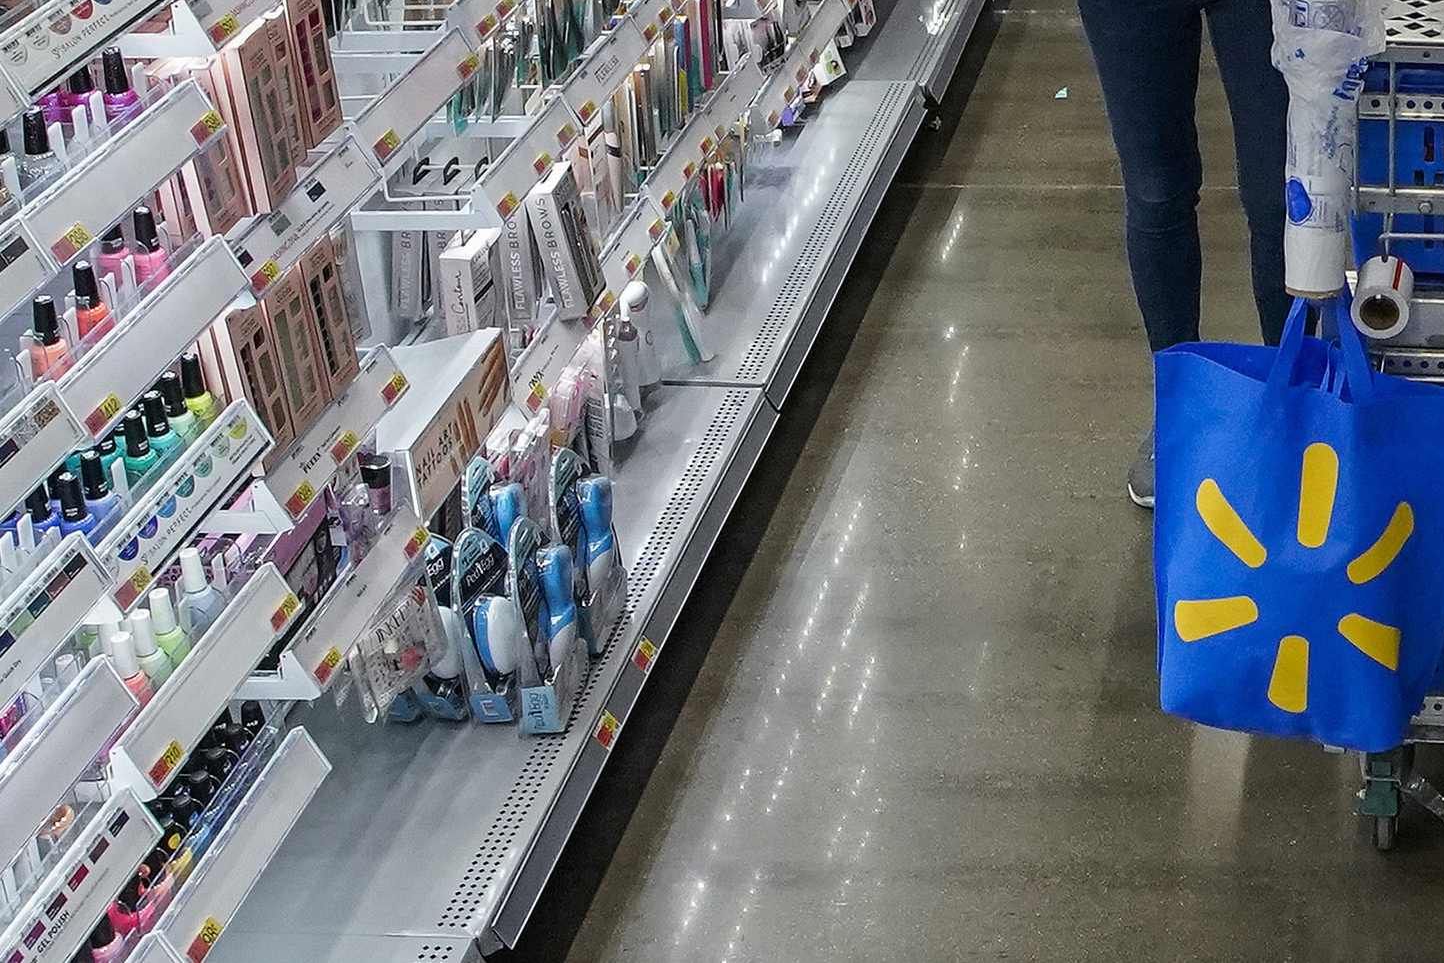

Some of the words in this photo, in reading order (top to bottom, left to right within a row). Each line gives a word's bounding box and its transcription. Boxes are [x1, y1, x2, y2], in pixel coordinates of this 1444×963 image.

[81, 14, 110, 36] PERFECT
[535, 197, 558, 249] BROWS
[552, 251, 574, 309] FLAWLESS
[509, 251, 526, 310] FLAWLESS
[415, 450, 438, 478] NAIL
[438, 422, 454, 447] ART
[416, 439, 455, 487] TATTOOS
[48, 909, 71, 937] POLISH
